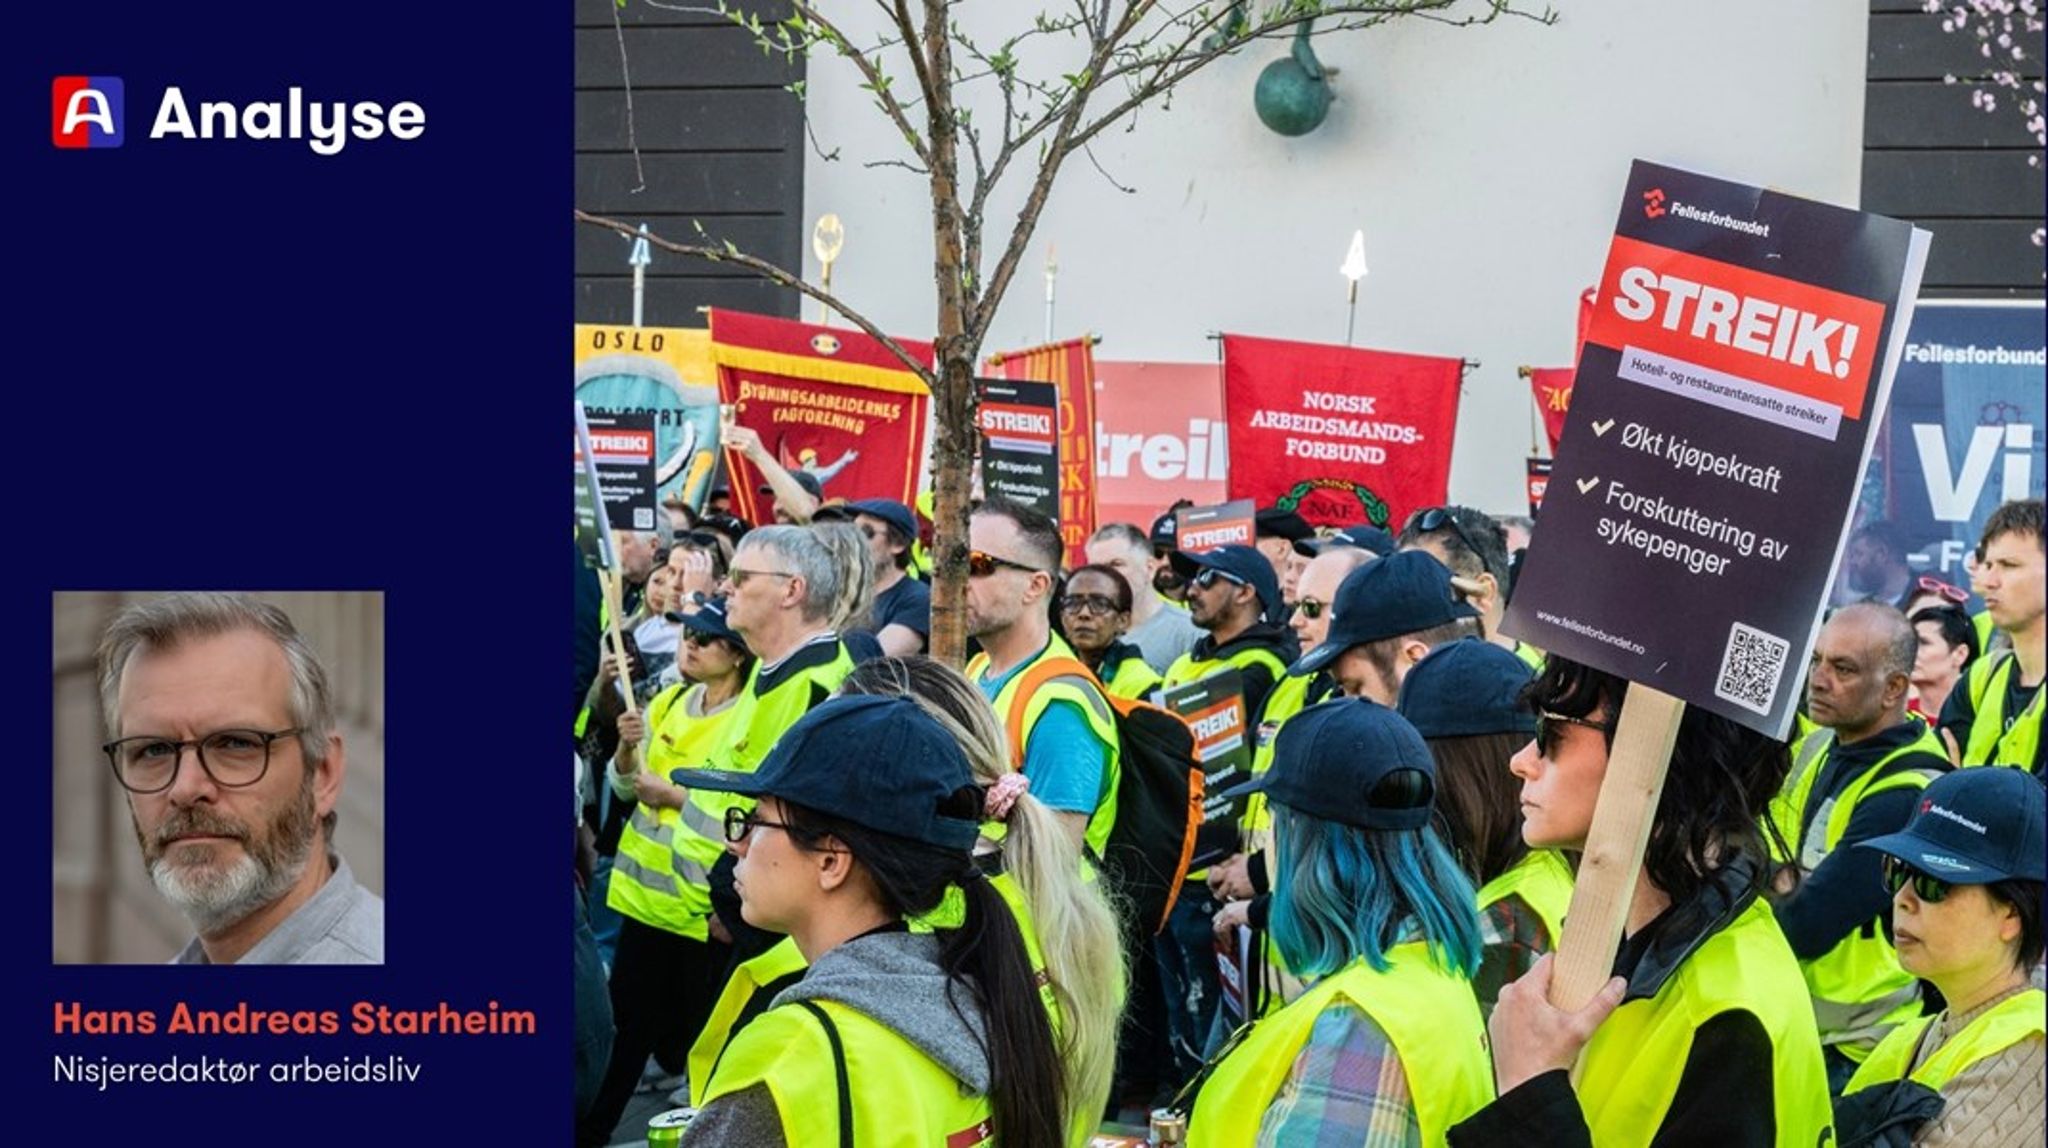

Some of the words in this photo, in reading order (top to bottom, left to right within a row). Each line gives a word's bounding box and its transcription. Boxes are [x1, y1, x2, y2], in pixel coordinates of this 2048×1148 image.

[1670, 201, 1770, 239] Fellesforbundet
[592, 330, 664, 352] OSLO
[1614, 266, 1860, 380] STREIK!
[1905, 344, 2047, 366] Fellesforbund
[739, 380, 901, 420] BYGNINGSARBEIDERNES
[1303, 390, 1376, 415] NORSK
[1670, 371, 1684, 386] og
[1685, 374, 1782, 411] restaurantansatte
[1784, 404, 1829, 426] streiker
[772, 408, 866, 436] FAGFORENING
[982, 410, 1050, 434] STREIK!
[1250, 410, 1424, 445] ARBEIDSMANDS-
[589, 434, 649, 452] TREIK!
[1094, 417, 1228, 481] trei
[1285, 437, 1387, 466] FORBUND
[1620, 421, 1662, 456] Økt
[1666, 434, 1782, 494] kjøpekraft
[1912, 423, 2033, 522] Vi
[1183, 525, 1248, 549] STREIK!
[1606, 480, 1756, 558] Forskuttering
[1760, 538, 1789, 561] av
[1596, 517, 1731, 577] sykepenger
[1190, 705, 1239, 741] TREIK!
